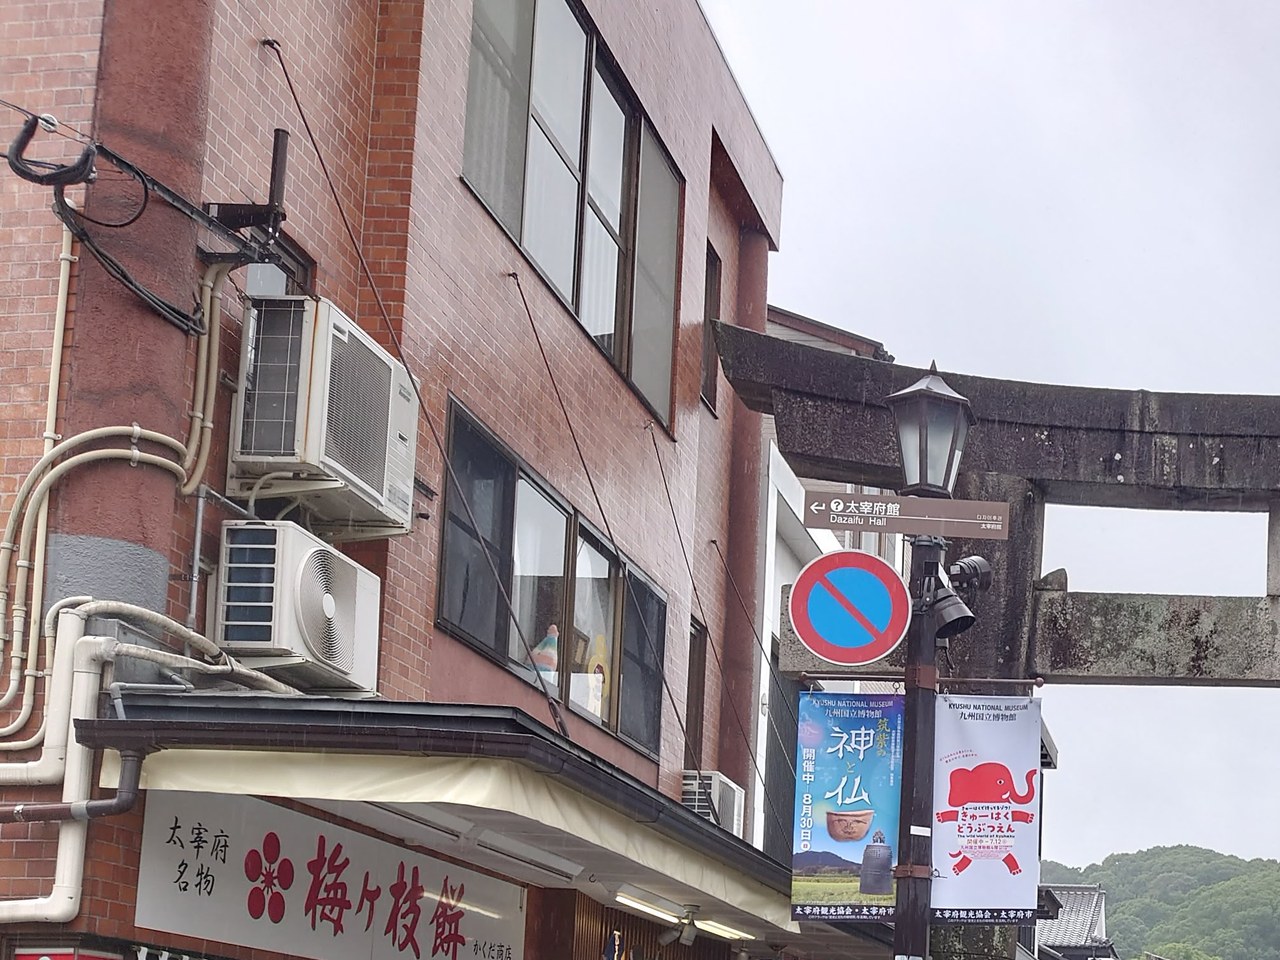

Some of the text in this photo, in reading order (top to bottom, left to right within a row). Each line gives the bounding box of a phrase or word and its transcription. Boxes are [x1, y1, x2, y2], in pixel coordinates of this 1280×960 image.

[846, 500, 900, 516] 太宰府館
[830, 515, 887, 527] Dazaifu Hall
[838, 700, 868, 708] NATIONAL
[825, 709, 882, 719] 九州国立博物館
[960, 712, 1017, 721] 九州国立博物館
[961, 811, 1010, 822] きゅーはく
[957, 823, 1015, 833] どうぶつえん
[165, 816, 230, 864] 太宰府
[173, 860, 215, 896] 名物
